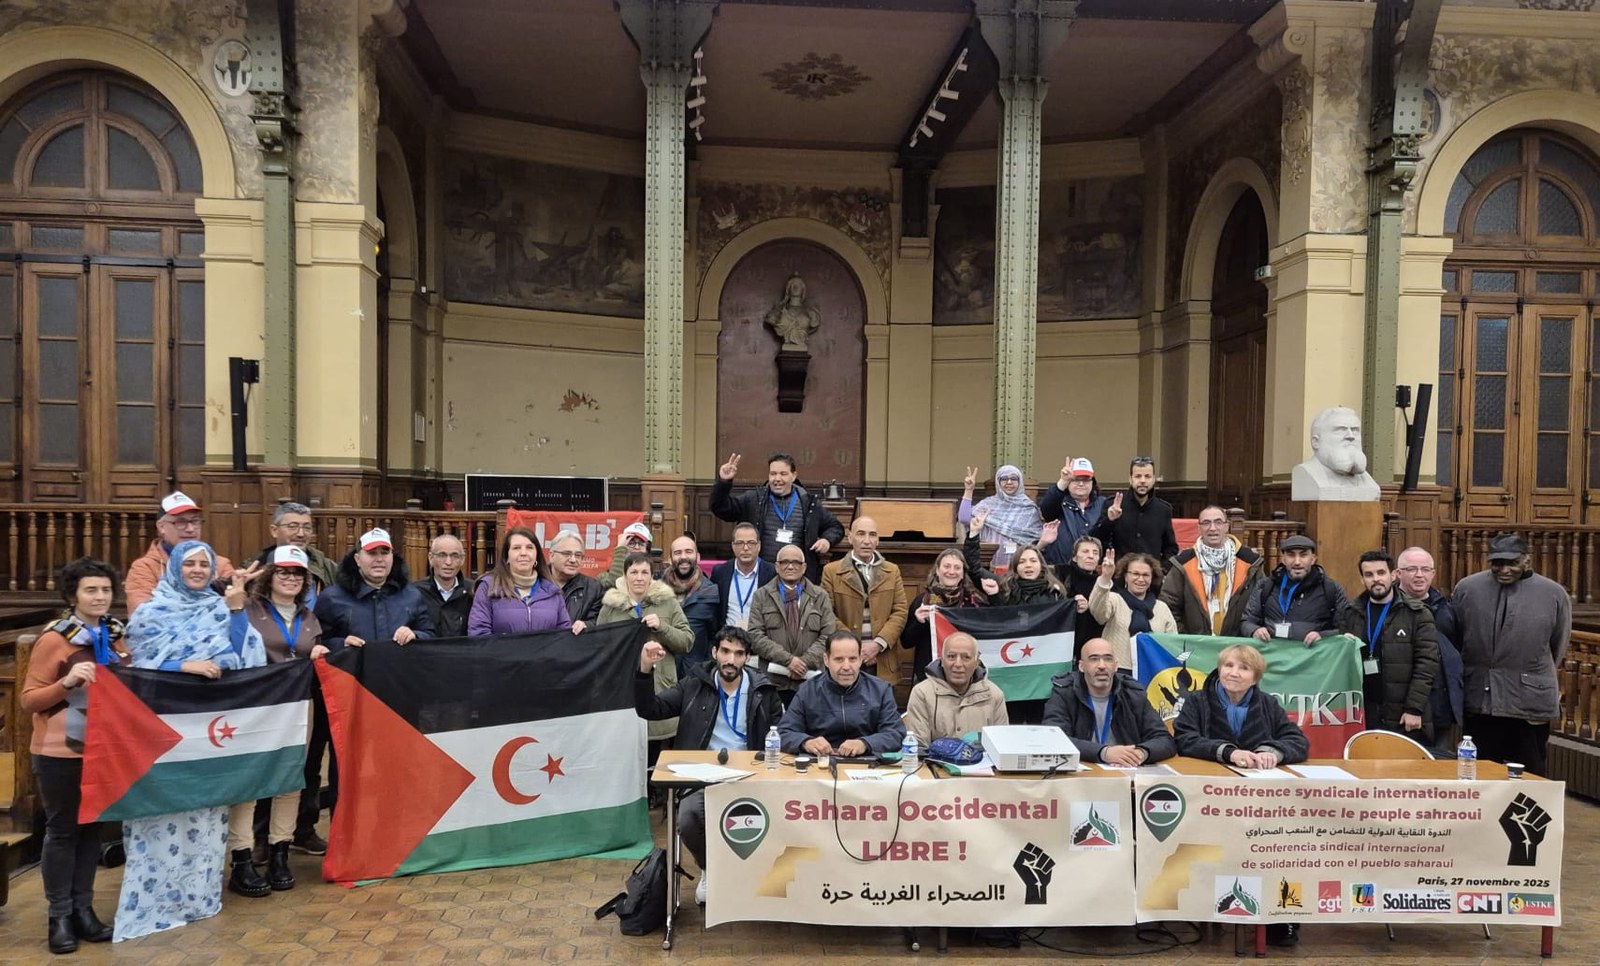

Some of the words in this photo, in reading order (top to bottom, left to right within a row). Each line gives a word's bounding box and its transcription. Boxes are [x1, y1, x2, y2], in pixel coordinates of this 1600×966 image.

[1270, 690, 1363, 726] TKE
[1202, 784, 1291, 798] Conférence
[1295, 785, 1369, 801] syndicale
[1373, 786, 1480, 800] internationale
[784, 800, 888, 822] Sahara
[898, 796, 1058, 821] Occidental
[1201, 804, 1220, 817] de
[1225, 804, 1296, 819] solidarité
[1300, 809, 1337, 819] avec
[1341, 807, 1354, 819] le
[1360, 808, 1411, 822] peuple
[1415, 808, 1482, 821] sahraoui
[1245, 826, 1284, 838] الصحراوي
[1285, 826, 1314, 835] الشعب
[1329, 827, 1365, 836] للتضامن
[1367, 827, 1395, 838] الدولية
[1397, 827, 1426, 838] النقابية
[1427, 828, 1451, 838] الندوة
[862, 841, 949, 862] LIBRE
[959, 841, 967, 861] !
[1250, 843, 1317, 853] Conferencia
[1319, 842, 1364, 852] sindical
[1368, 843, 1445, 853] internacional
[1241, 858, 1256, 869] de
[1260, 857, 1321, 869] solidaridad
[1324, 860, 1345, 869] con
[1347, 858, 1358, 869] el
[1361, 858, 1401, 871] pueblo
[1404, 857, 1454, 869] saharaui
[1417, 876, 1448, 887] Paris,
[1450, 878, 1464, 886] 27
[1465, 877, 1520, 887] novembre
[1523, 878, 1550, 888] 2025
[821, 882, 853, 904] حرة
[860, 882, 920, 906] الغربية
[1318, 895, 1341, 912] cgt
[1383, 893, 1451, 910] Solidaires
[1458, 895, 1501, 912] CNT
[1525, 900, 1553, 909] USTKE
